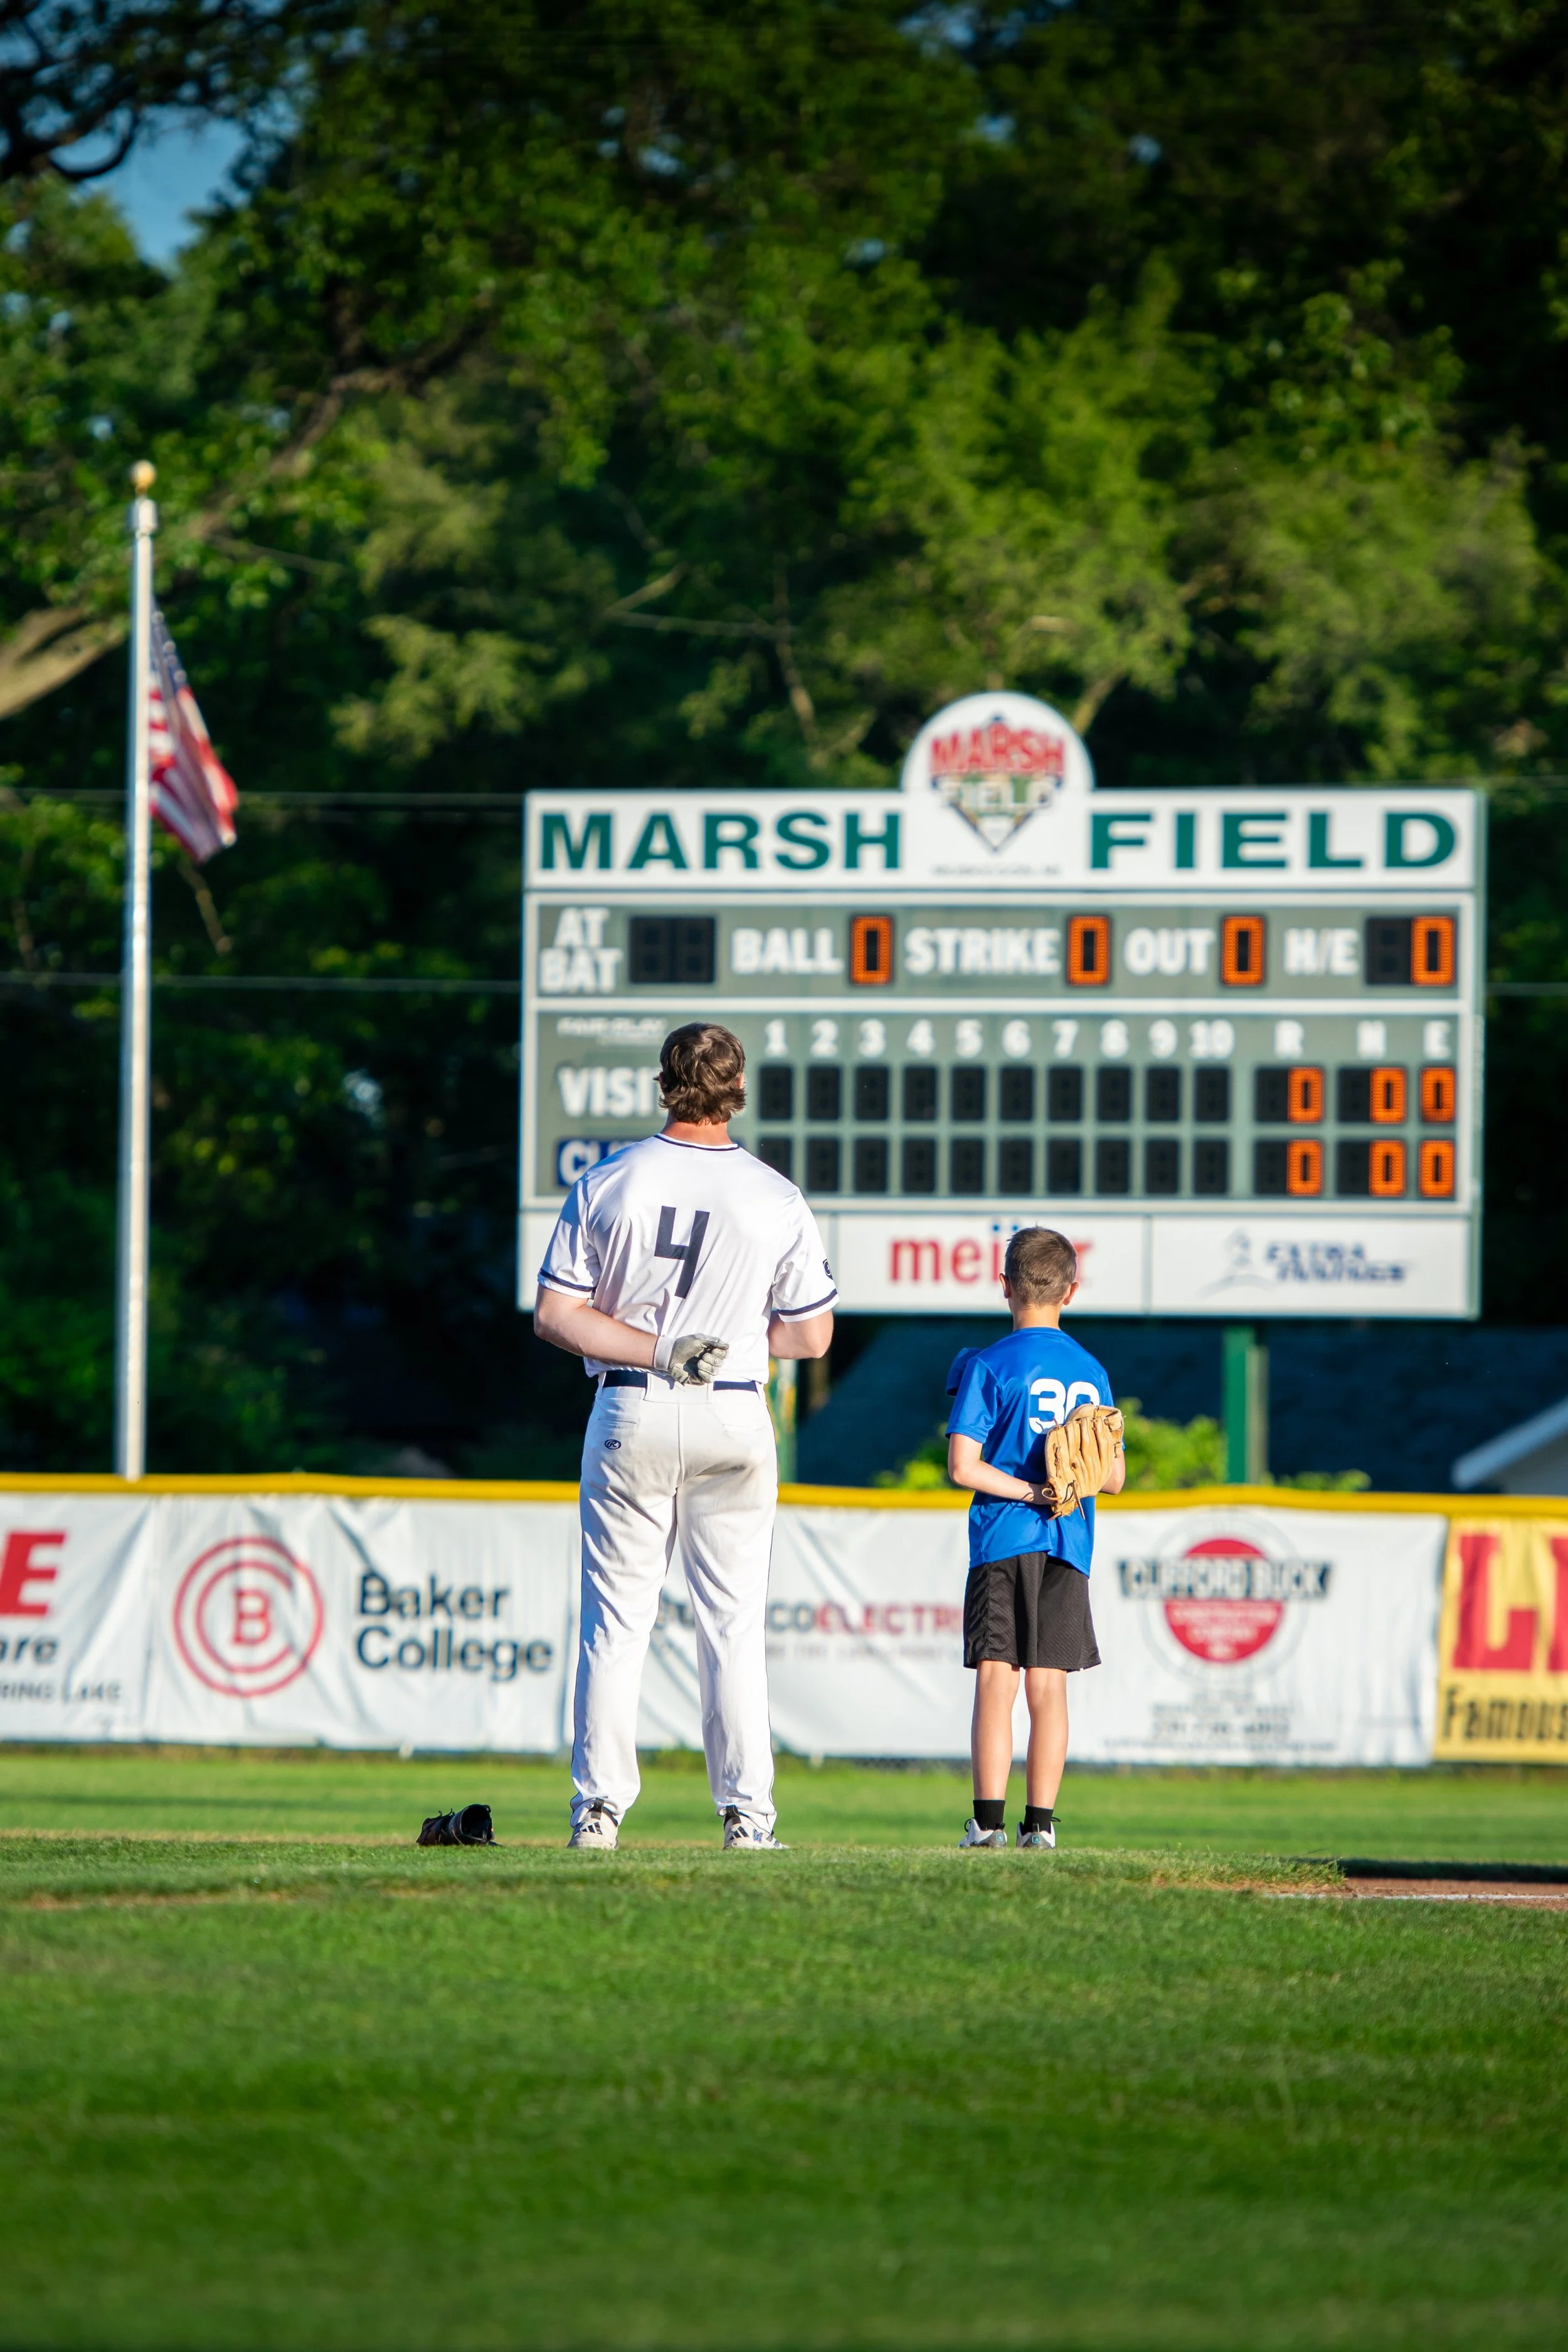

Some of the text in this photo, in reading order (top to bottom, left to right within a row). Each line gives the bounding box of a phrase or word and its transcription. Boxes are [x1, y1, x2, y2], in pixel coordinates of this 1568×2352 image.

[931, 721, 1065, 776] MARSH
[541, 812, 1455, 870] MARSH FIELD
[555, 908, 611, 948] AT
[732, 916, 1454, 986] BALL 0 STRIKE 0 OUT 0 H/E 0
[540, 949, 622, 992] BAT
[766, 1019, 788, 1056] 1
[812, 1020, 838, 1056] 2
[859, 1020, 886, 1057] 3
[907, 1020, 935, 1056] 4
[956, 1020, 983, 1057] 5
[1004, 1020, 1030, 1057] 6
[1052, 1020, 1079, 1057] 7
[1100, 1020, 1128, 1058] 8
[1149, 1020, 1177, 1058] 9
[1191, 1020, 1234, 1057] 10
[1274, 1020, 1303, 1058] R
[1425, 1020, 1451, 1059] E
[654, 1205, 710, 1300] 4
[359, 1572, 509, 1619] Baker
[357, 1624, 553, 1680] College
